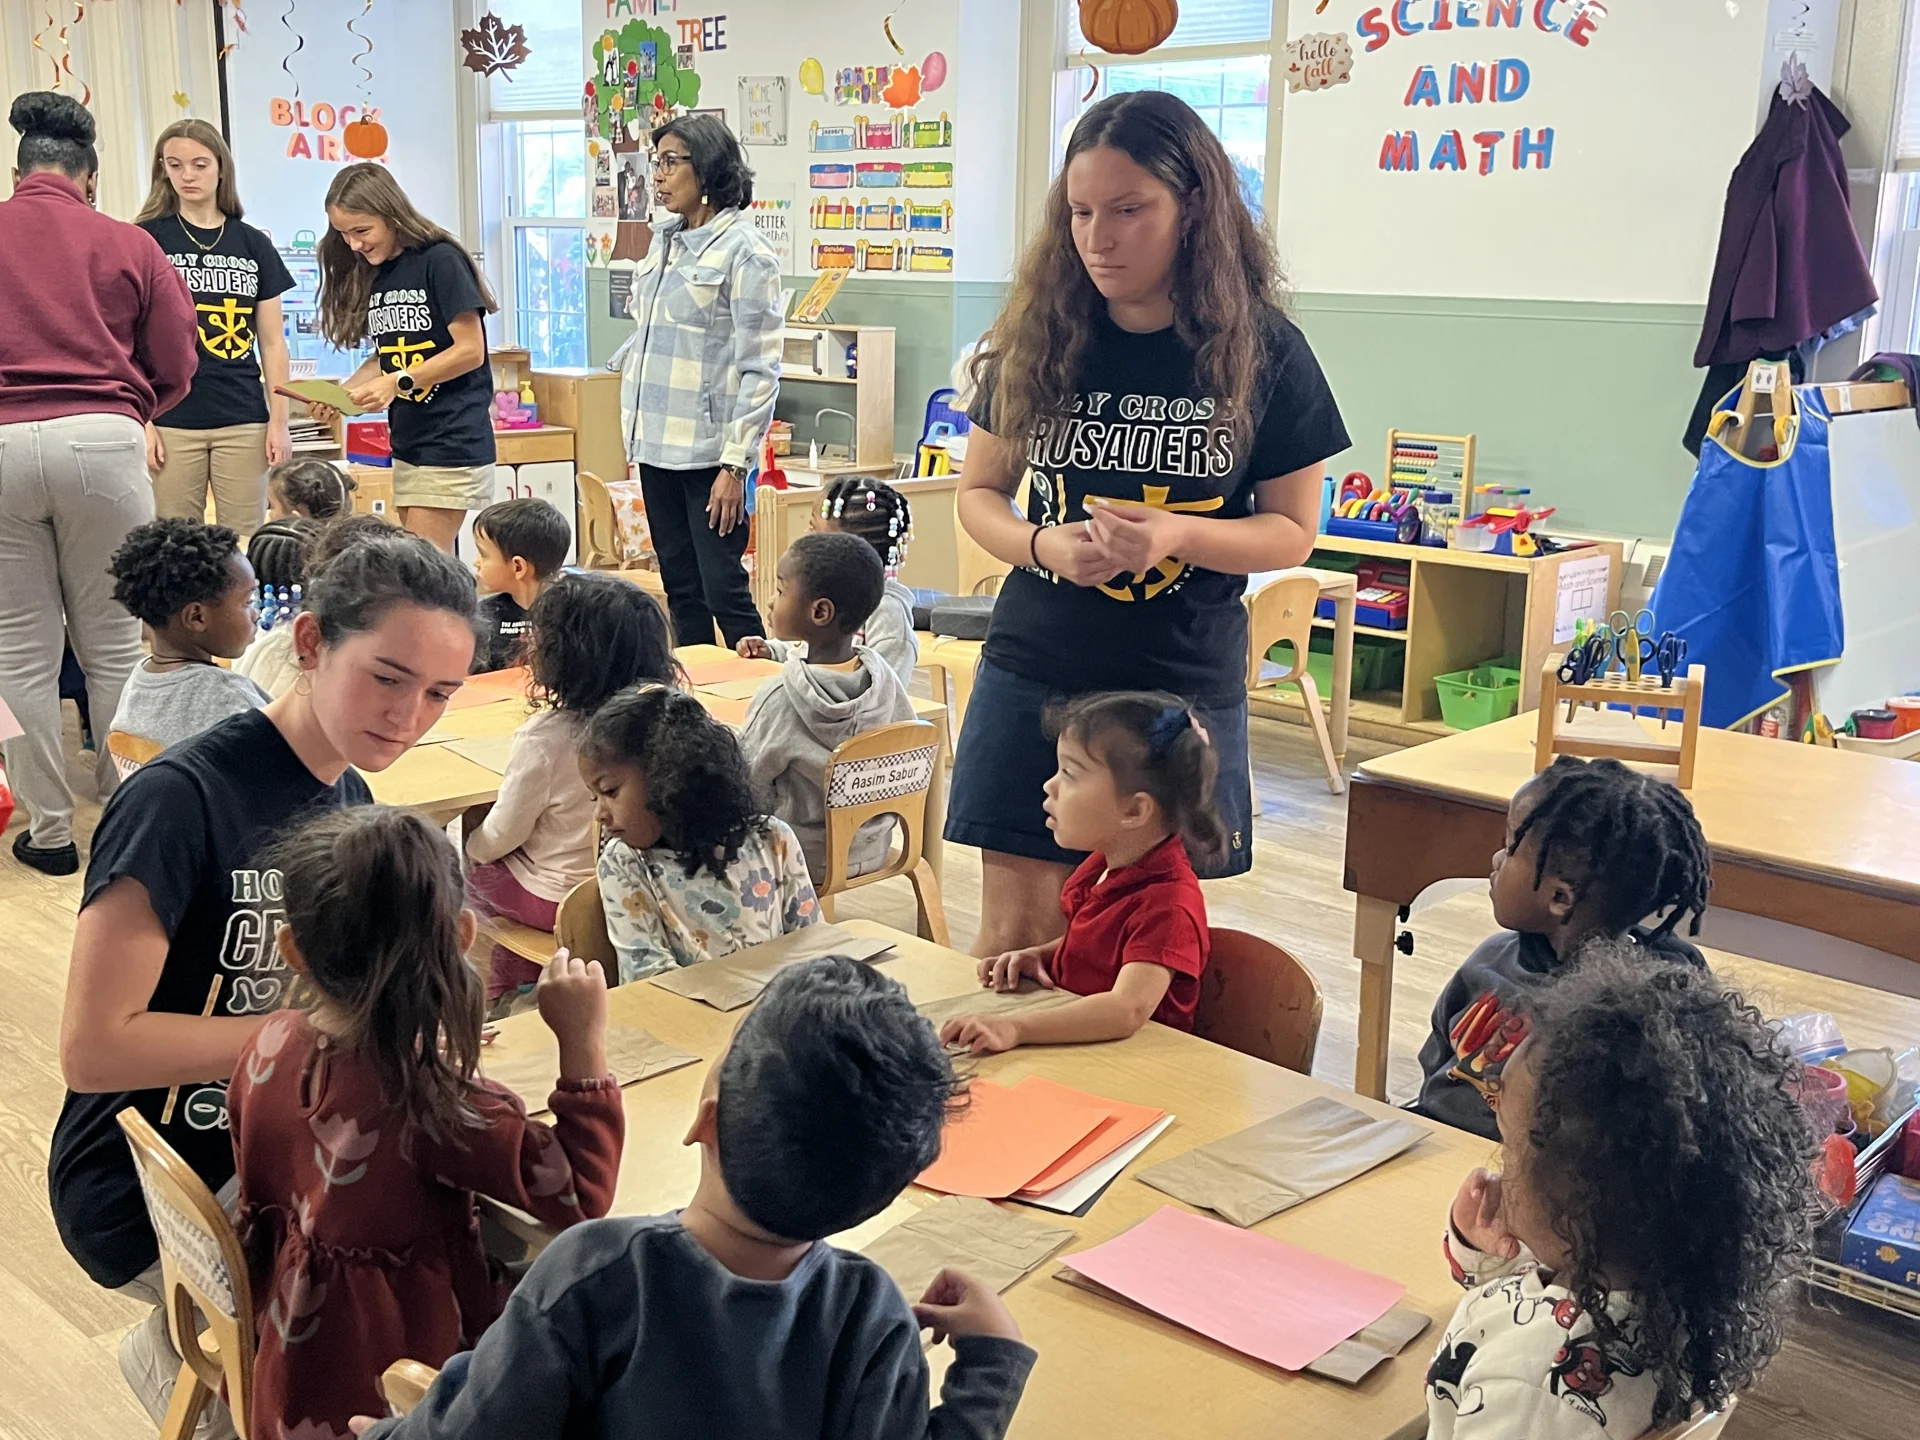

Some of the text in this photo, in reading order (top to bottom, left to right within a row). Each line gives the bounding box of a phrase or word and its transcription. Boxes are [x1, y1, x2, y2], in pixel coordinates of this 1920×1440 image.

[676, 15, 727, 52] TREE
[1356, 0, 1609, 52] SCIENCE
[1299, 40, 1337, 61] hello
[1304, 58, 1333, 87] fall
[1403, 58, 1530, 107] AND
[286, 132, 390, 163] AR
[1378, 127, 1555, 176] MATH
[754, 215, 787, 229] BETTER
[761, 230, 790, 242] ether
[166, 253, 259, 272] OLY CROSS
[175, 267, 259, 297] USADERS
[368, 289, 427, 309] LY CROSS
[368, 305, 432, 336] USADERS
[1057, 392, 1112, 416] LY
[851, 766, 919, 790] Aasim Sabur
[231, 868, 285, 903] HO
